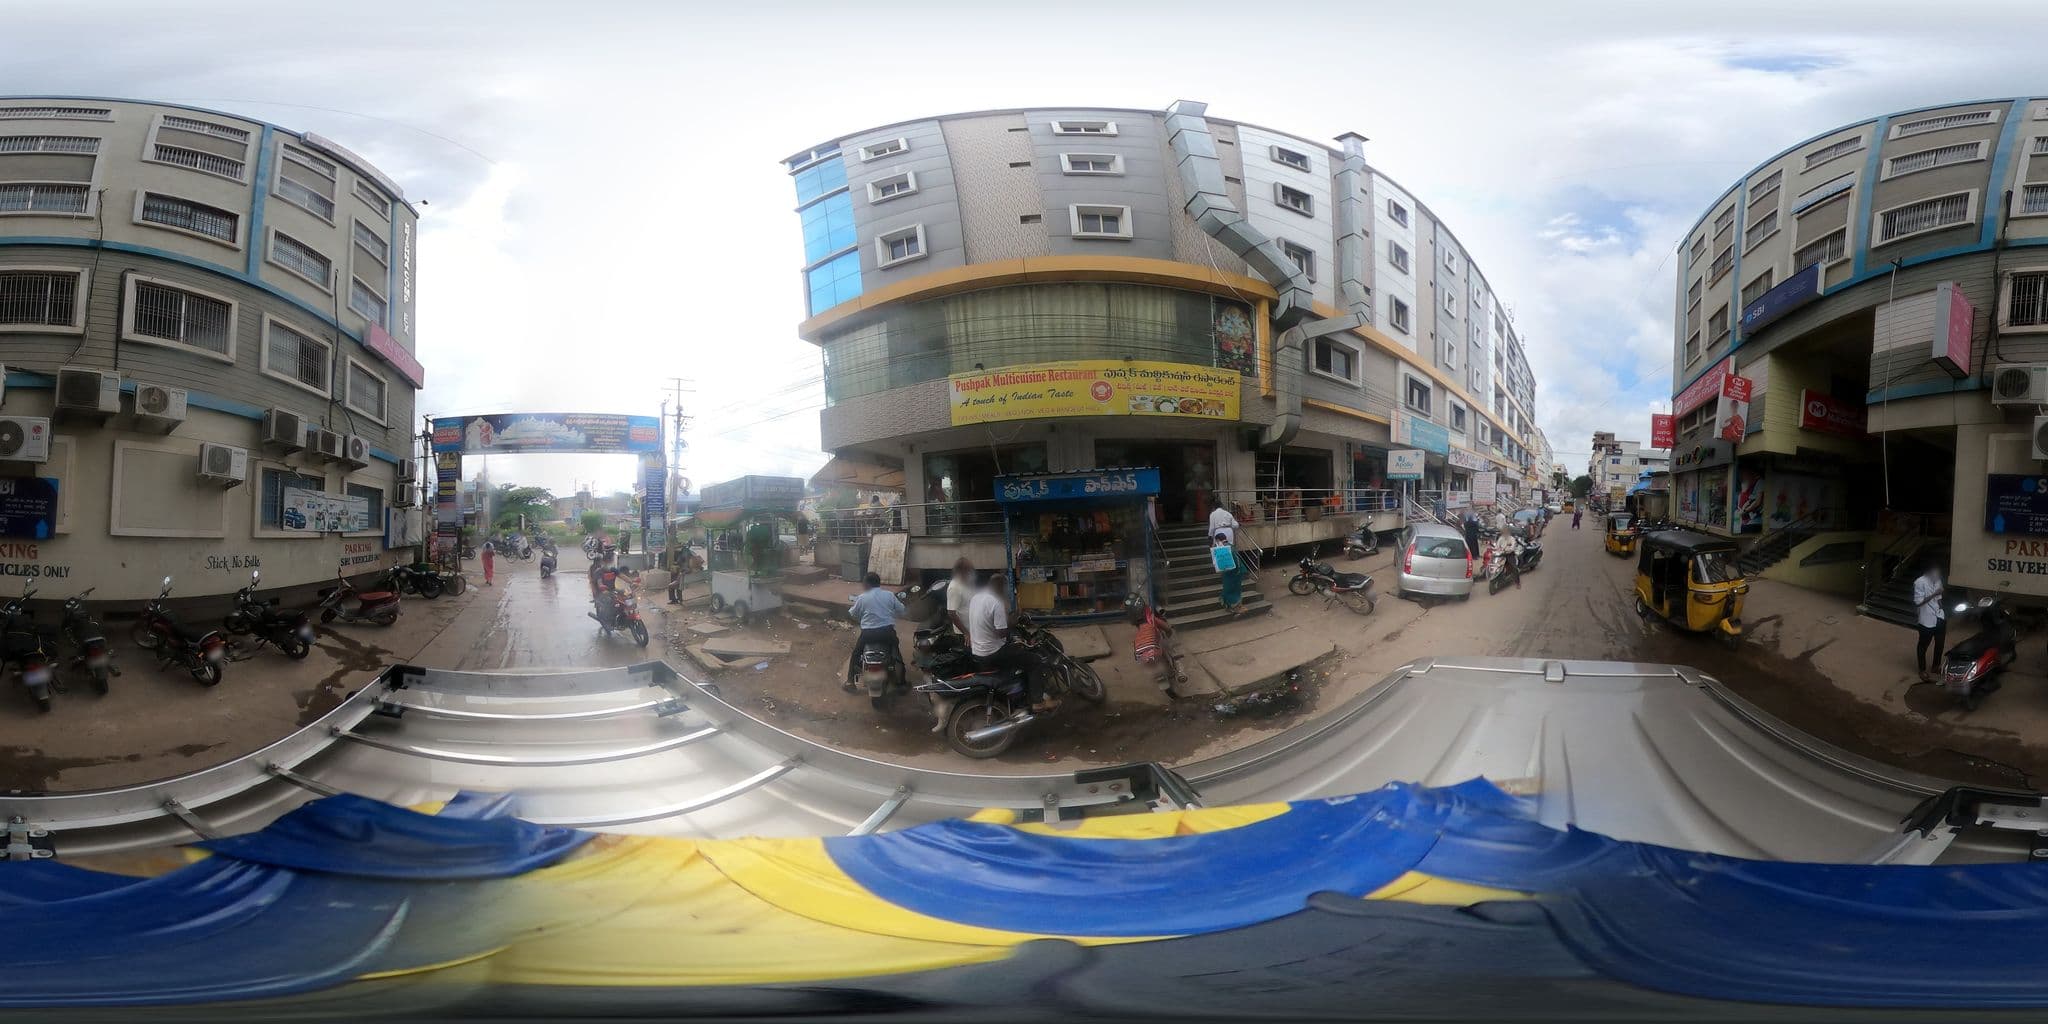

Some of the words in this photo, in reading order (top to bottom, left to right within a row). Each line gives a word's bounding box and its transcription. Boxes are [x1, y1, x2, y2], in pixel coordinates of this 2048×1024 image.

[1752, 304, 1765, 320] SBI
[955, 377, 991, 393] Pushpak
[992, 370, 1047, 387] Multicuisine
[1048, 369, 1096, 382] Restaurant
[959, 397, 969, 408] A
[973, 395, 995, 406] touch
[998, 394, 1008, 405] of
[1011, 391, 1043, 402] Indian
[1047, 388, 1074, 399] Taste
[43, 565, 71, 578] ONLY
[205, 556, 230, 573] Stick
[232, 555, 243, 569] No
[1987, 558, 2012, 572] SBI
